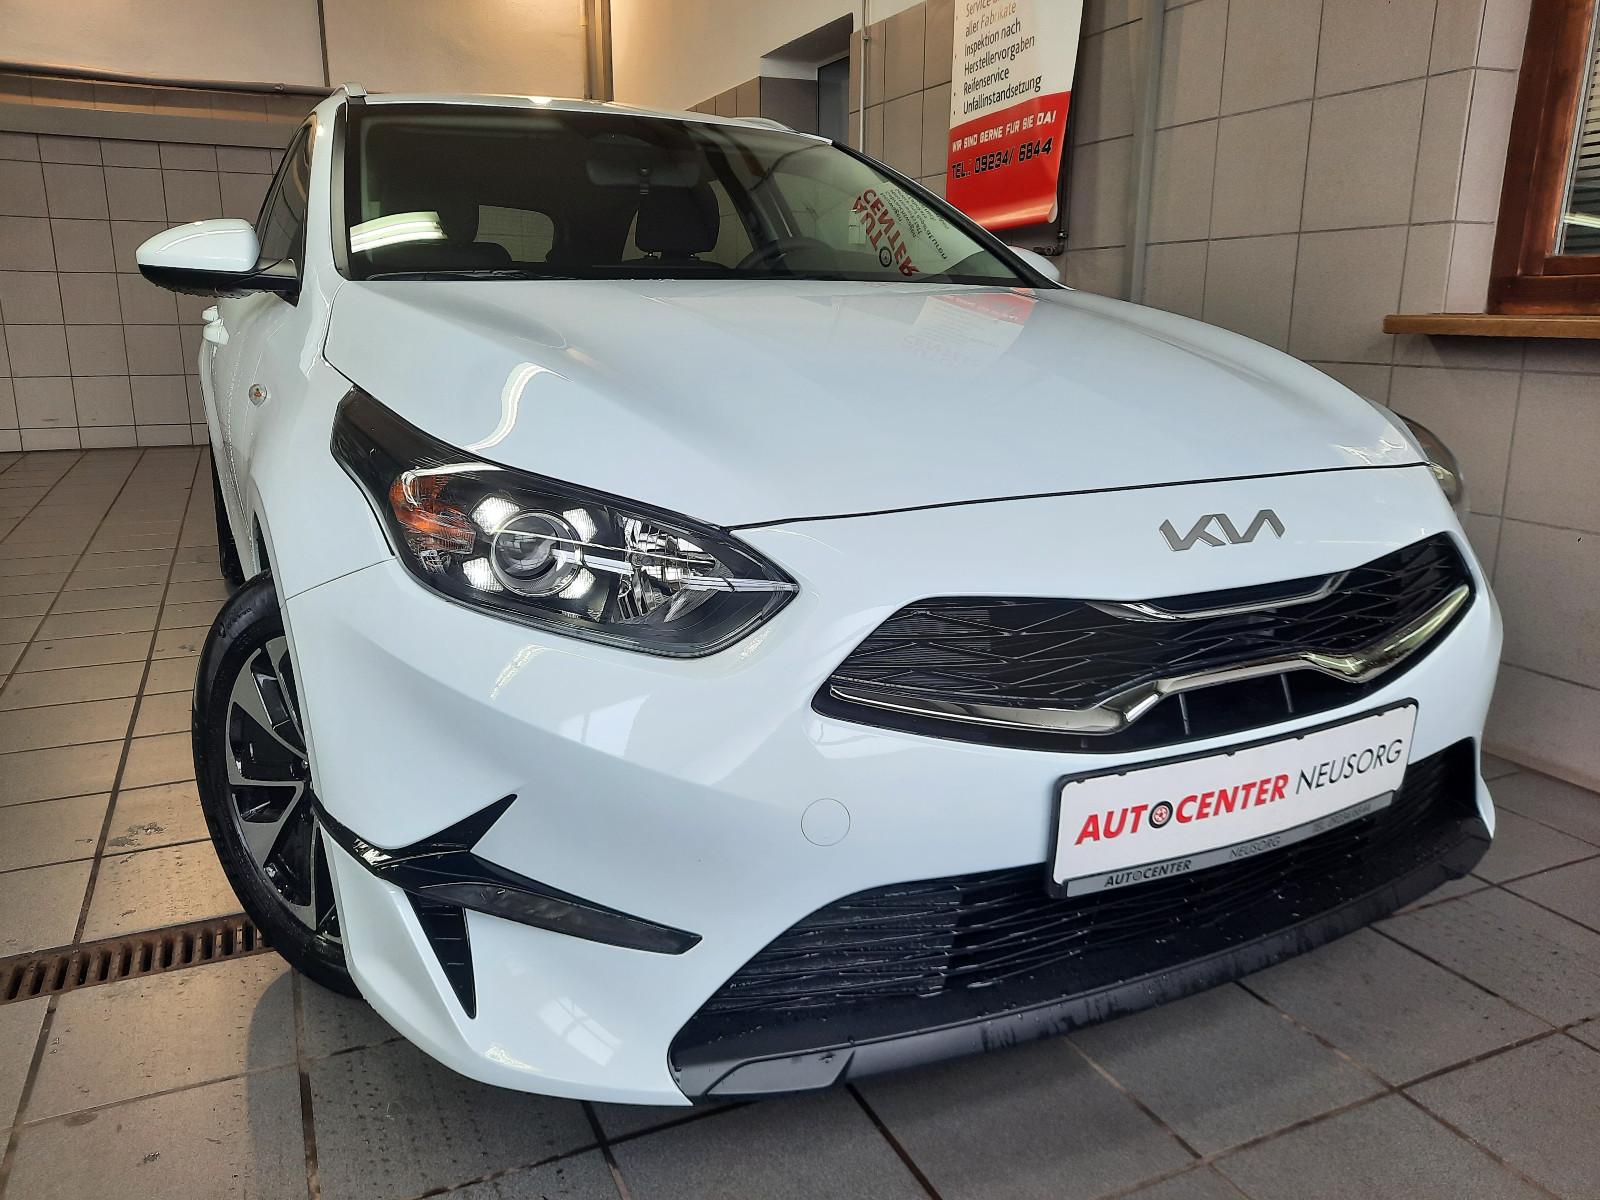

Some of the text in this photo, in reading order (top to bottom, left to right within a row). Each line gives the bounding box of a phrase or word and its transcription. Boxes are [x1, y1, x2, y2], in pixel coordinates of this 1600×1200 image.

[964, 17, 1022, 58] Inspektion nach
[965, 1, 1016, 38] aller Fabrikate
[964, 35, 1035, 76] Herstellervorgaben
[963, 67, 1010, 96] Reifenservice
[963, 74, 1042, 115] Unfallinstandsetzung
[963, 133, 978, 149] SIND
[979, 126, 1004, 143] GERNE
[1022, 114, 1035, 130] SIE
[1036, 110, 1057, 126] DA!
[1159, 509, 1286, 552] KIA
[1295, 738, 1404, 795] NEUSORG
[1229, 835, 1282, 860] NEUSORG
